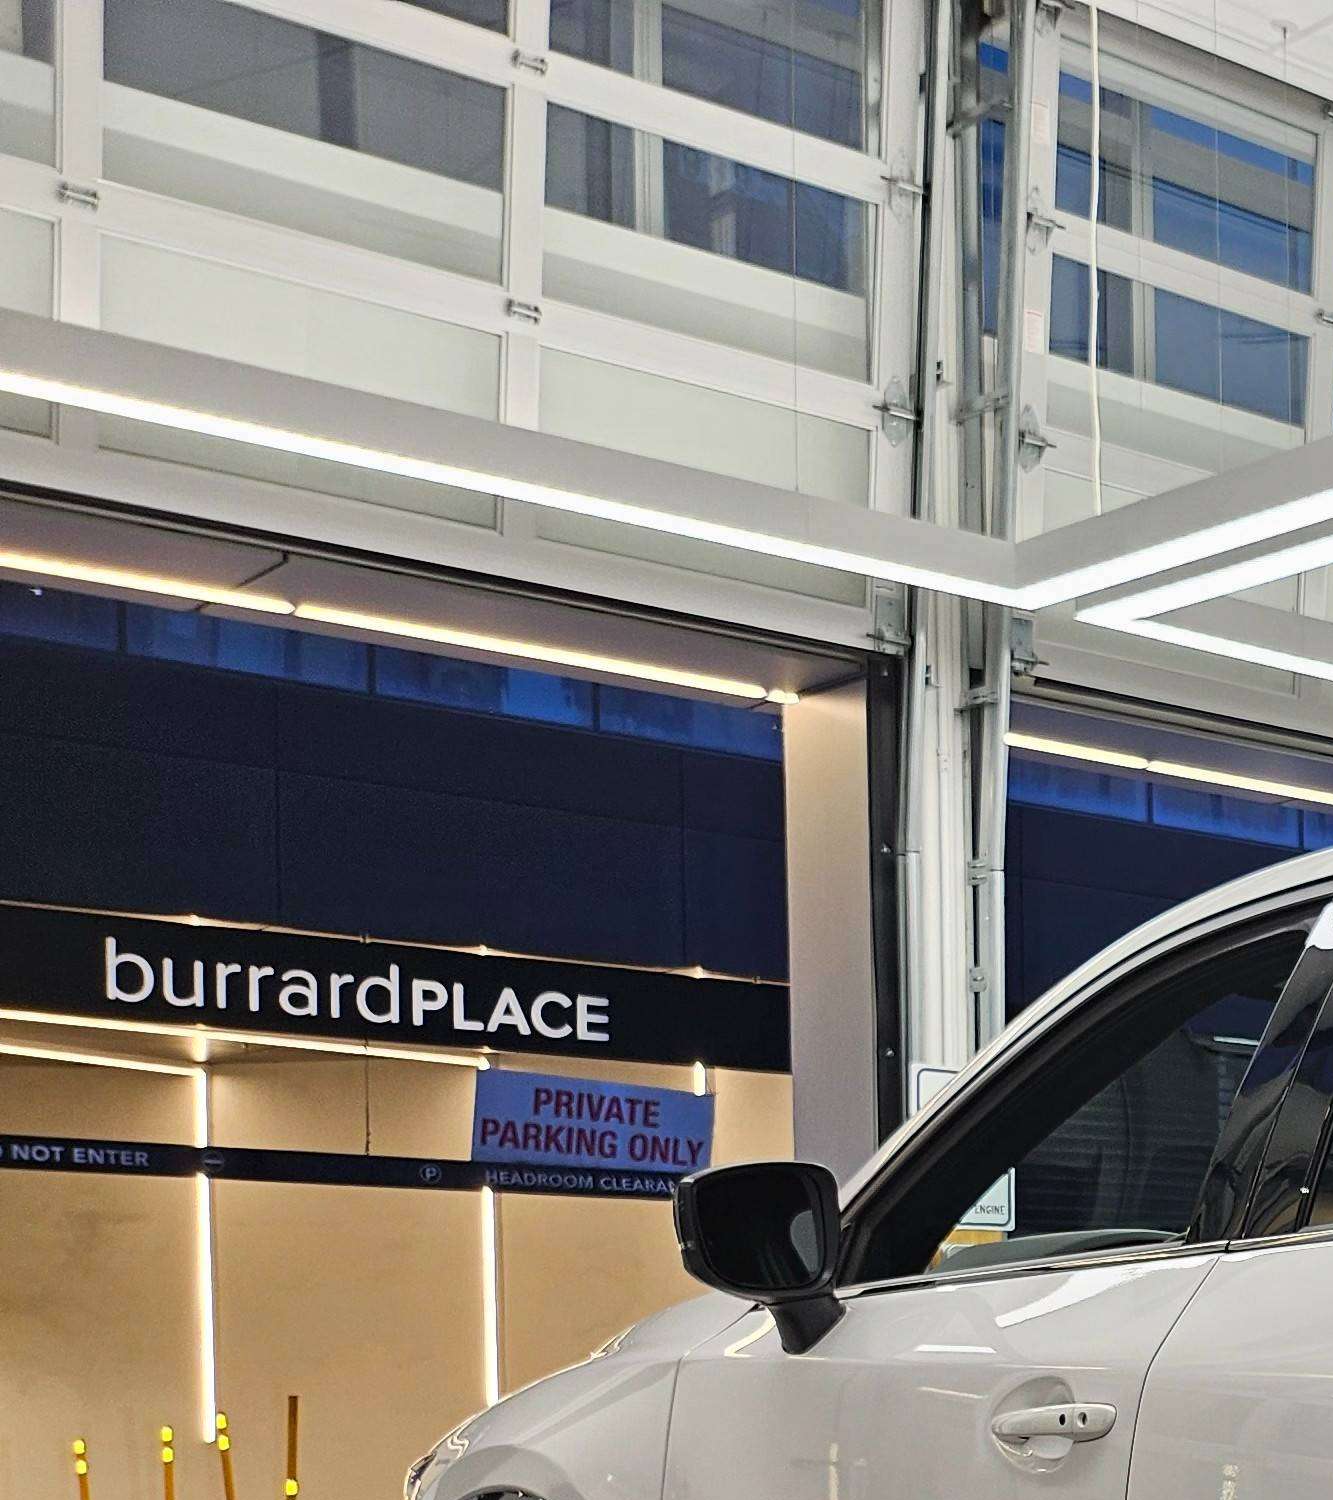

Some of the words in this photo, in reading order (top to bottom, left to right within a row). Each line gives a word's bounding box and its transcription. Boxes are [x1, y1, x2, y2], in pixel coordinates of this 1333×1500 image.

[105, 936, 610, 1042] burrardPLACE
[533, 1087, 661, 1129] PRIVATE
[12, 1144, 65, 1162] NOT
[72, 1147, 150, 1167] ENTER
[480, 1117, 617, 1159] PARKING
[628, 1133, 704, 1168] ONLY
[485, 1169, 594, 1190] HEADROOM
[975, 1204, 1006, 1216] ENGINE
